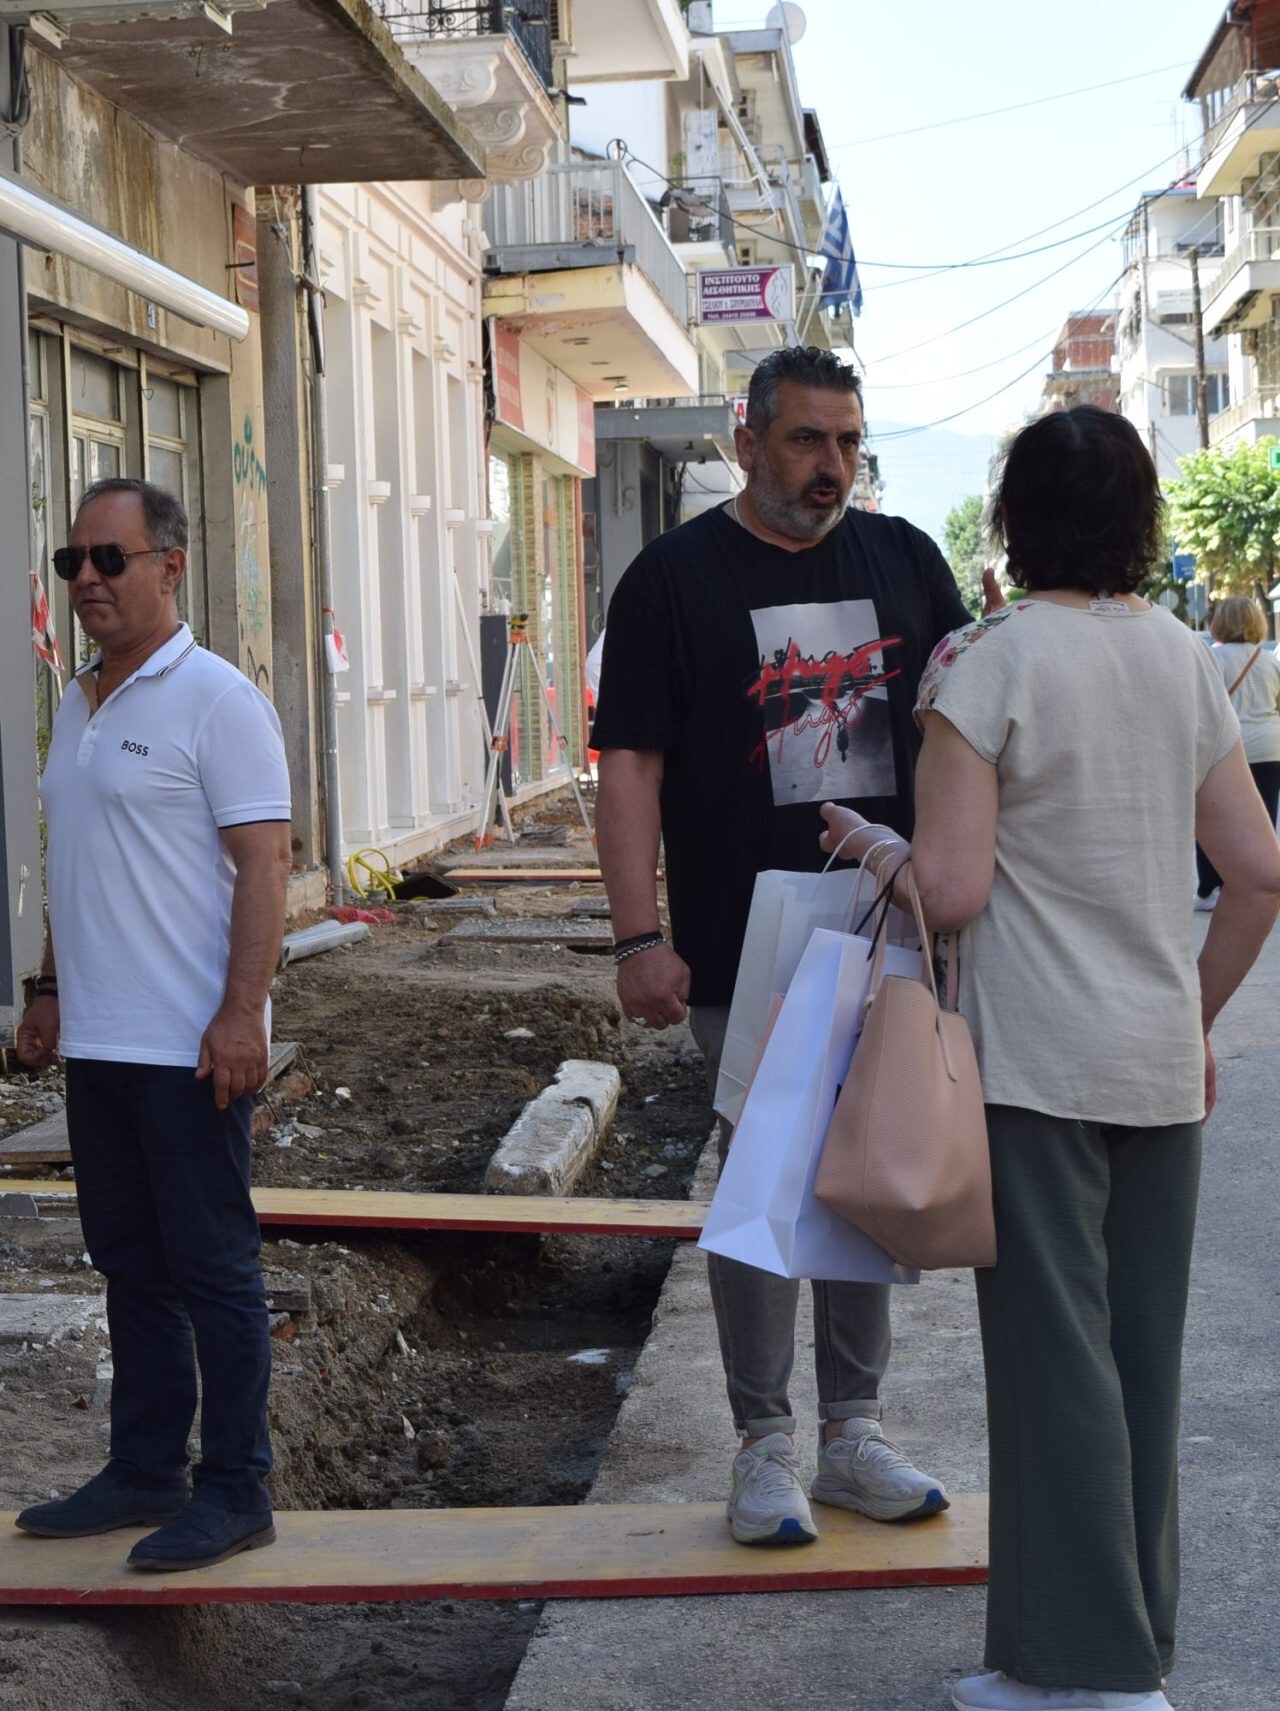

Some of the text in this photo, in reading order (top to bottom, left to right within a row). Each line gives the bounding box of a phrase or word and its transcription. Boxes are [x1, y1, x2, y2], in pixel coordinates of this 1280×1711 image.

[704, 274, 760, 286] ΙΝΣΤΙΤΟΥΤΟ
[703, 284, 761, 296] ΑΙΣΘΗΤΙΚΗΣ
[121, 740, 149, 757] BOSS
